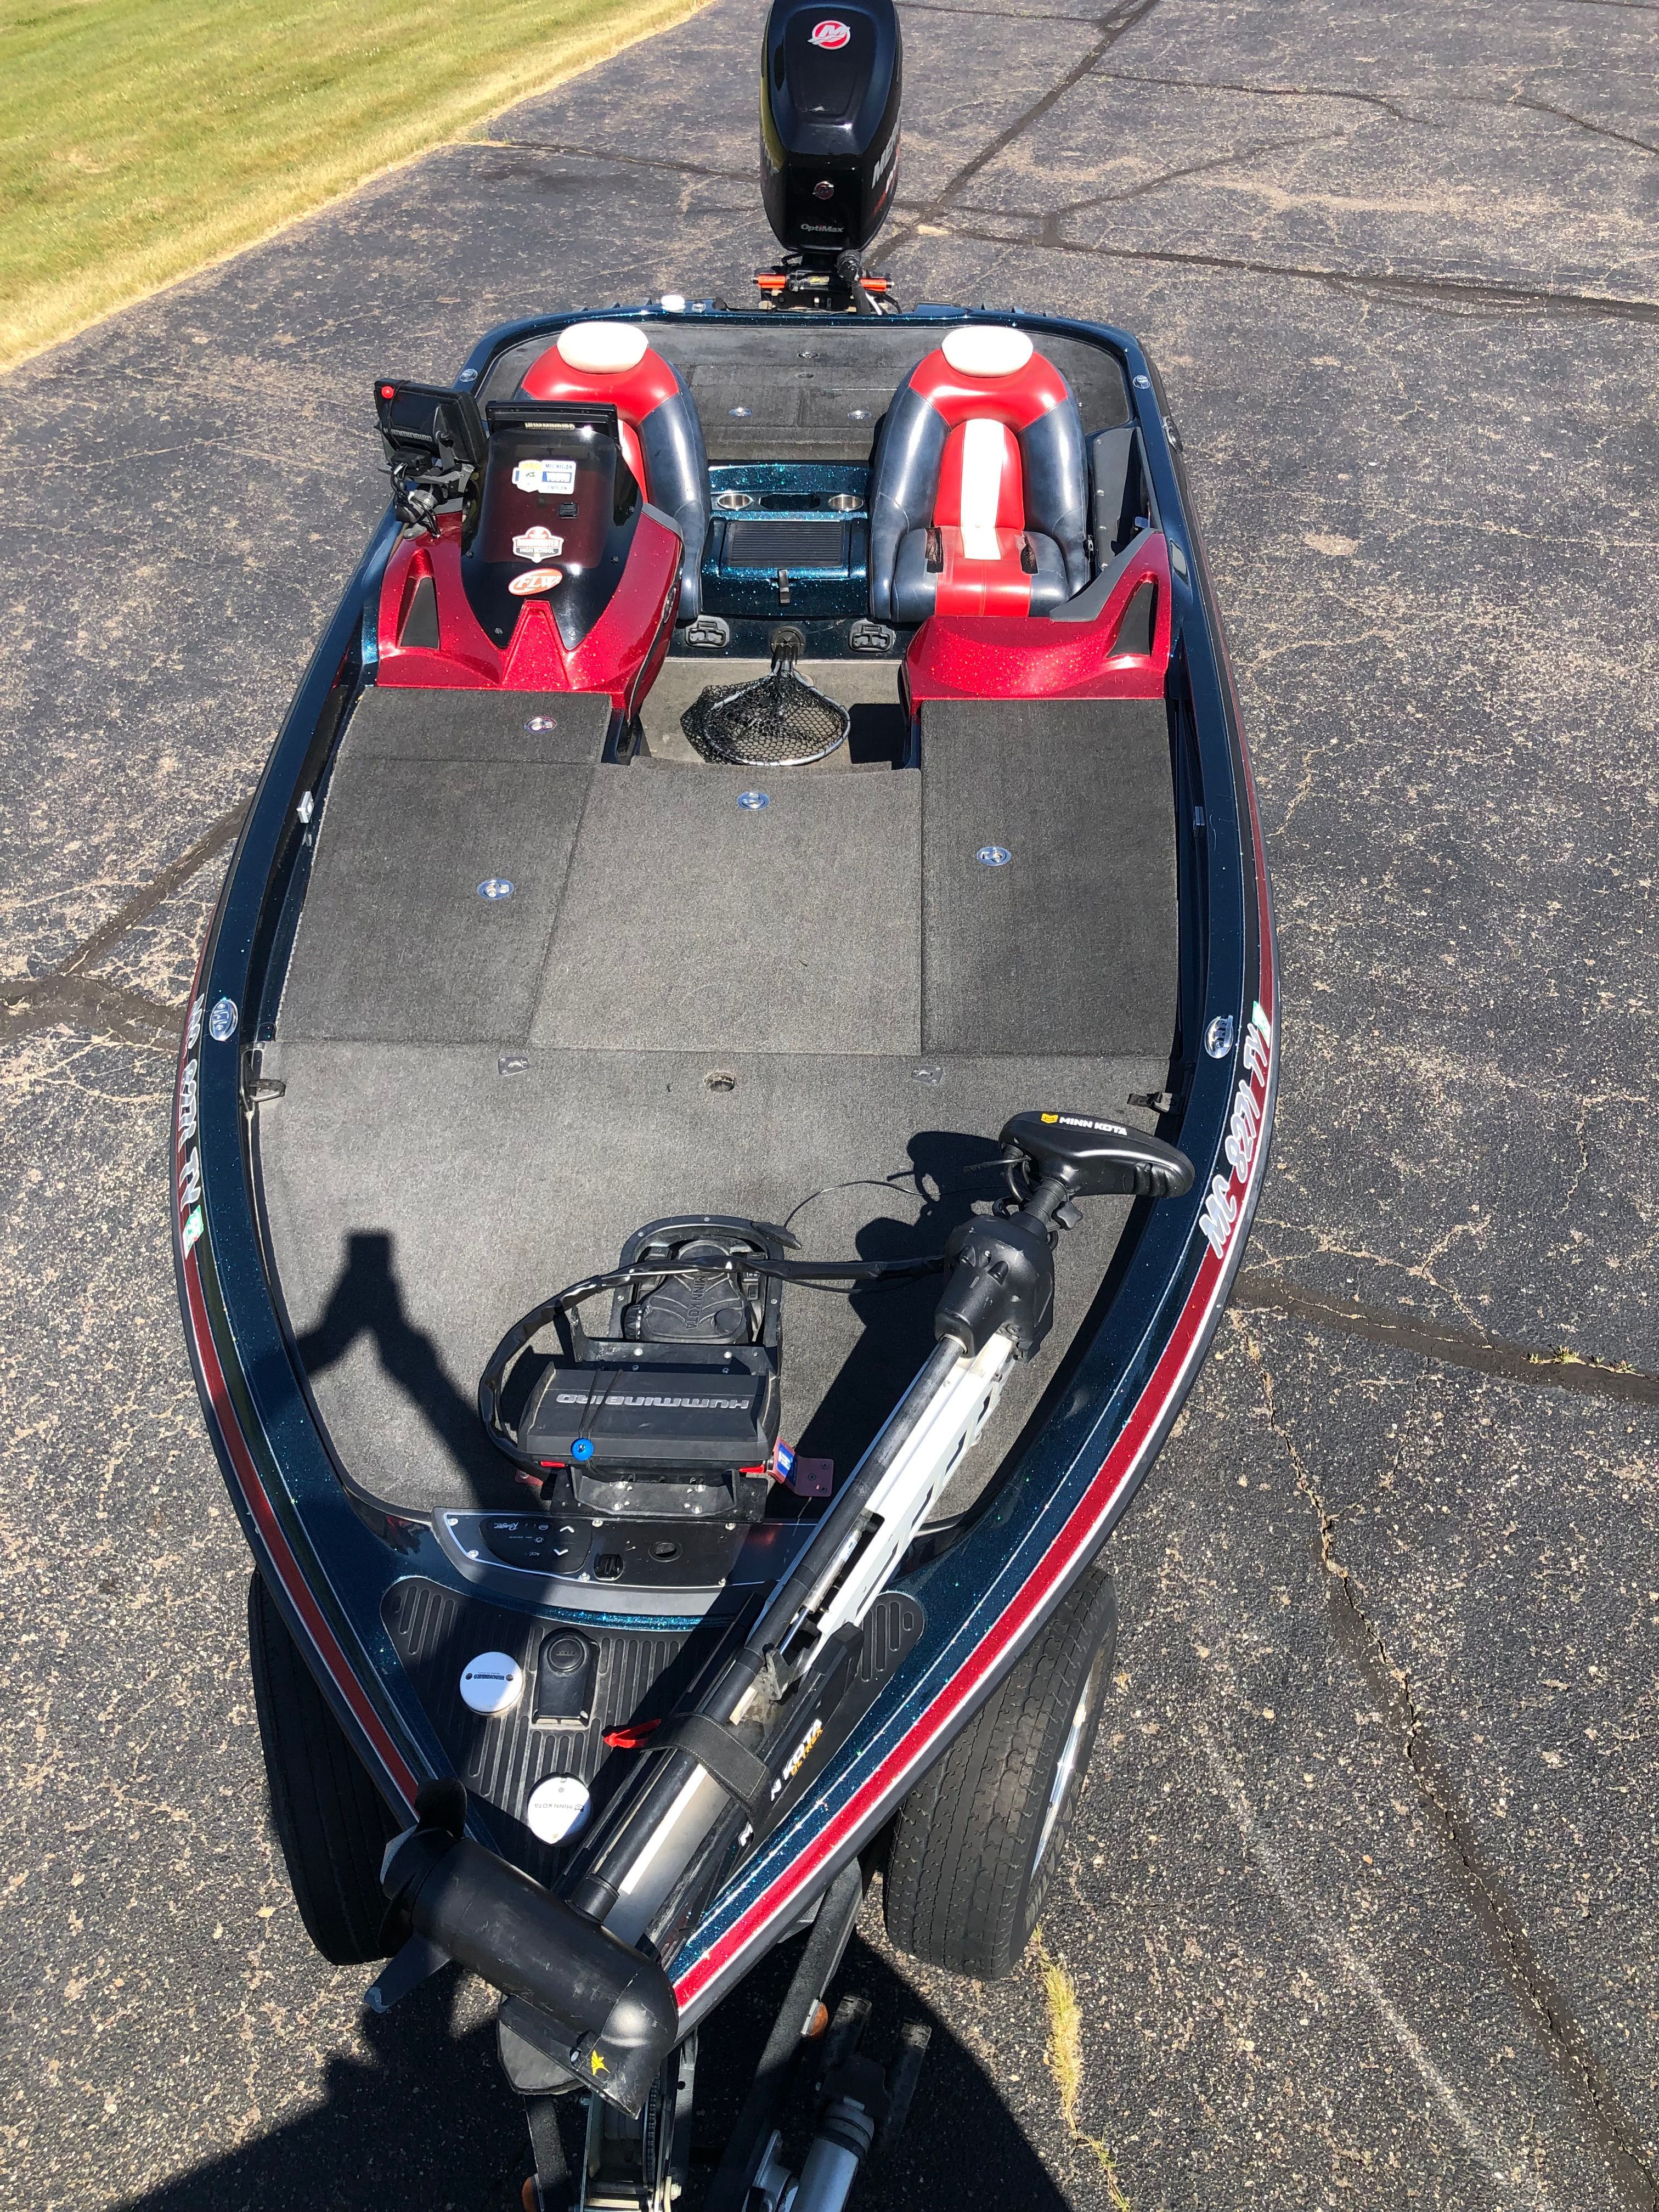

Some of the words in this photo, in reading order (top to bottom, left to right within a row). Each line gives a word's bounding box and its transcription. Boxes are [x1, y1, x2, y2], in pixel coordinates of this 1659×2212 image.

[800, 224, 844, 232] OptiMax
[516, 575, 559, 589] FLW
[1059, 1116, 1093, 1128] MINN
[1094, 1122, 1127, 1136] KOTA
[1199, 1174, 1237, 1259] MC
[1224, 1080, 1260, 1183] 8271
[1244, 1023, 1268, 1088] TY
[690, 1275, 707, 1301] MINN
[685, 1304, 702, 1330] KOTA
[556, 1393, 749, 1409] HUMMINBIRD
[783, 1718, 822, 1781] KOTA
